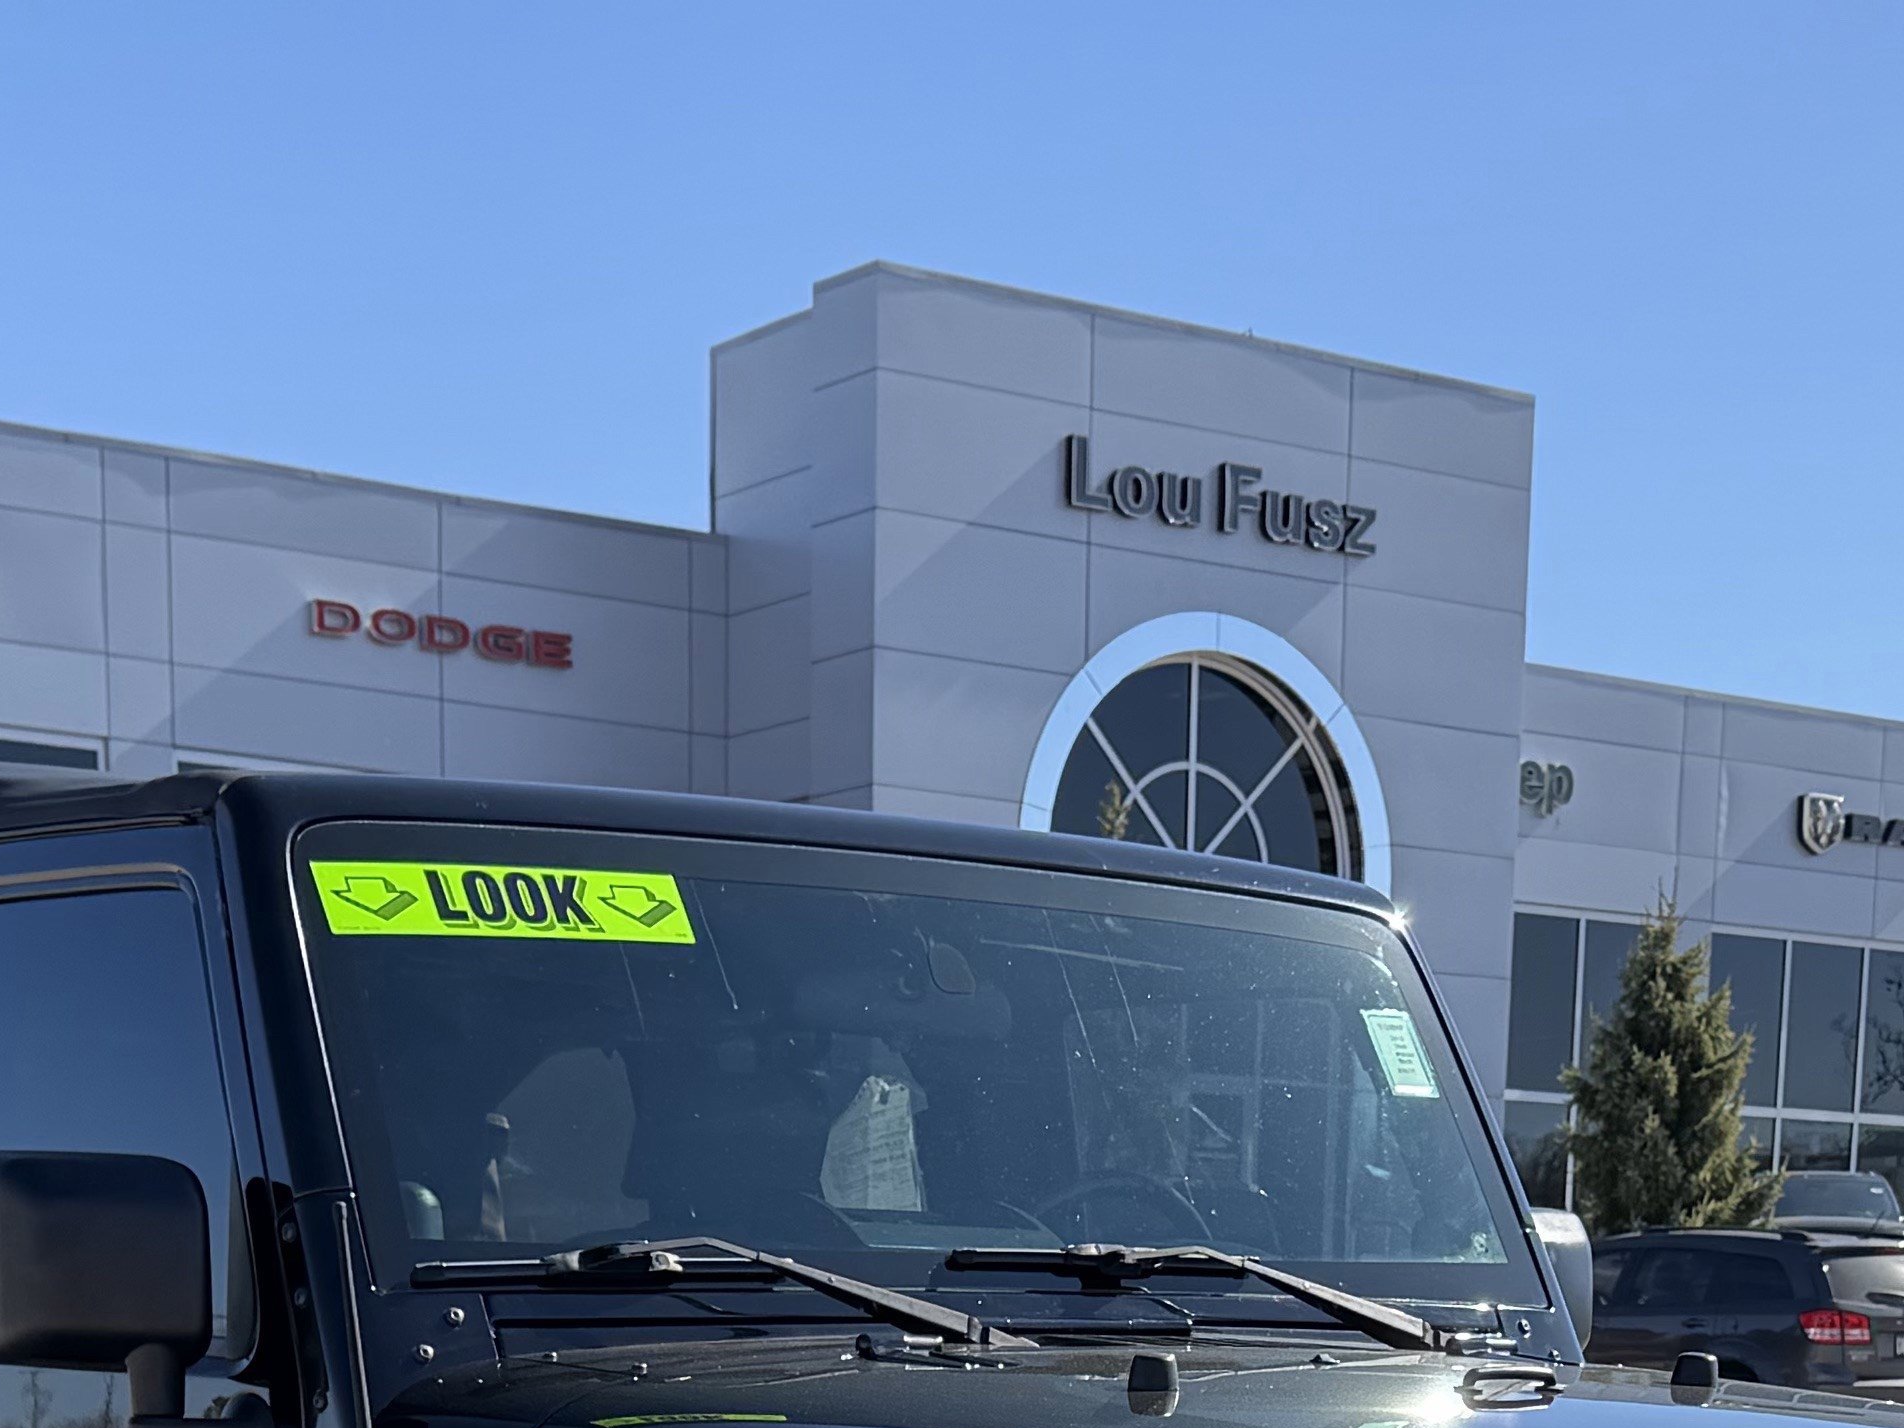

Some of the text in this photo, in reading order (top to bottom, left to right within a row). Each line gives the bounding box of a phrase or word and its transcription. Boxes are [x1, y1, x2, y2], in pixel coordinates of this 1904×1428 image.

[1064, 434, 1377, 557] Lou Fusz
[308, 598, 574, 669] DODGE
[1520, 760, 1574, 818] ep
[423, 869, 605, 934] LOOK
